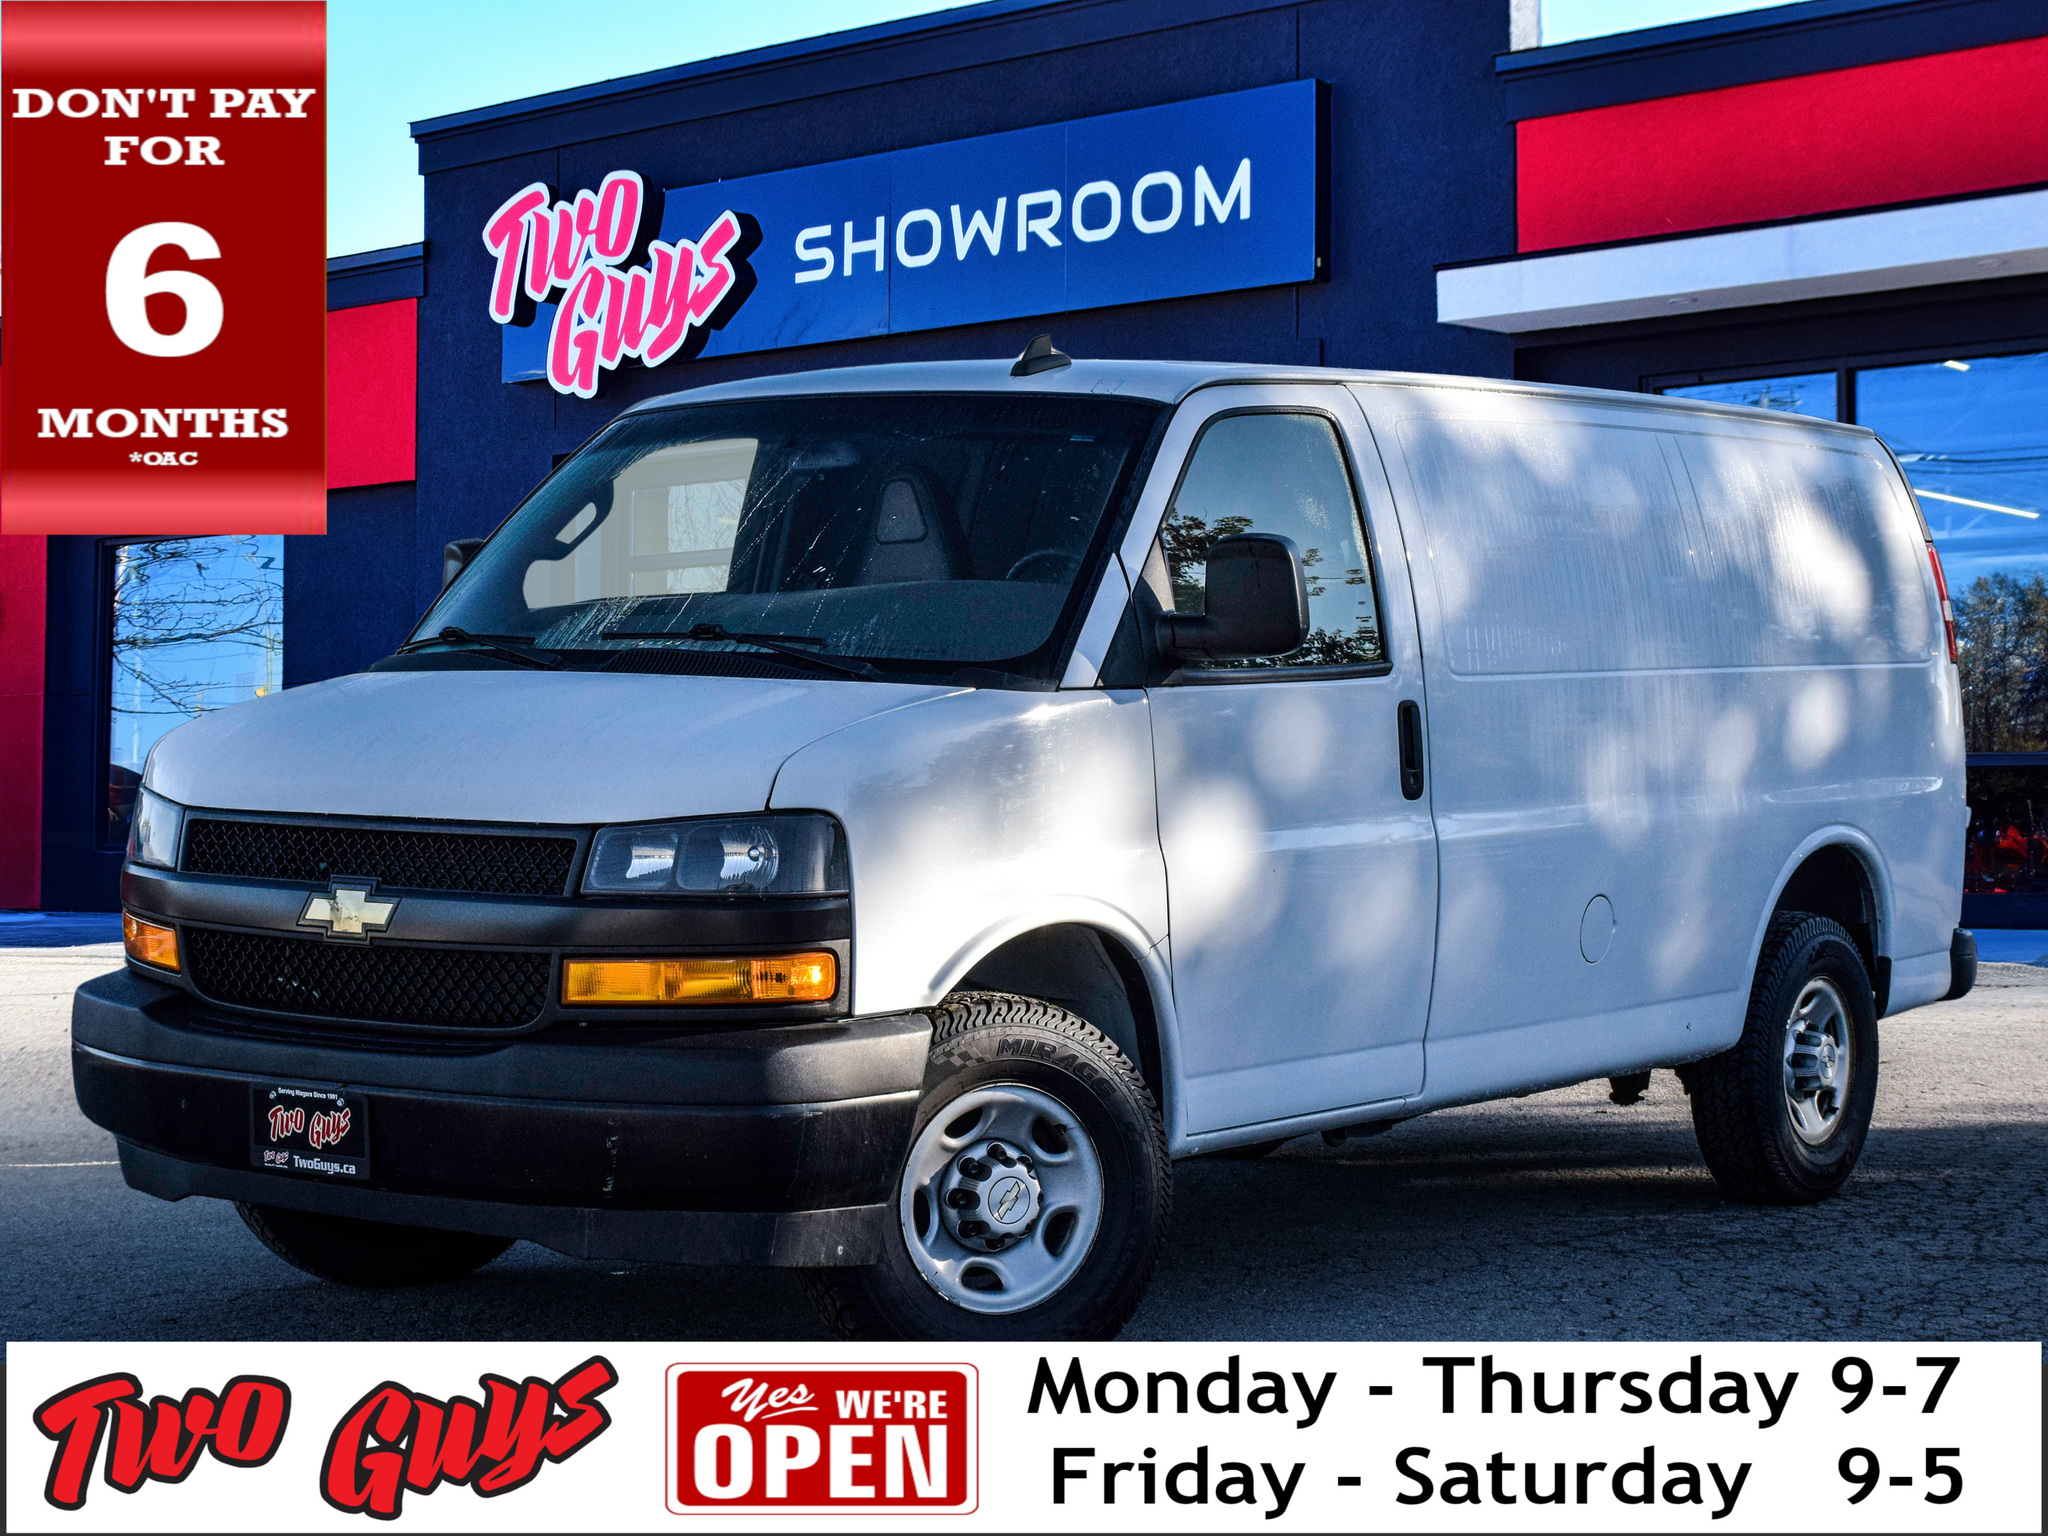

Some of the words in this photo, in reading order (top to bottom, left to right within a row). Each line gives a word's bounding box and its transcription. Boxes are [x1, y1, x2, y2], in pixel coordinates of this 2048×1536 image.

[794, 158, 1251, 284] SHOWROOM
[996, 1037, 1118, 1098] MIRAGE
[313, 1091, 326, 1099] Since
[292, 1155, 356, 1175] TwoGuys.ca
